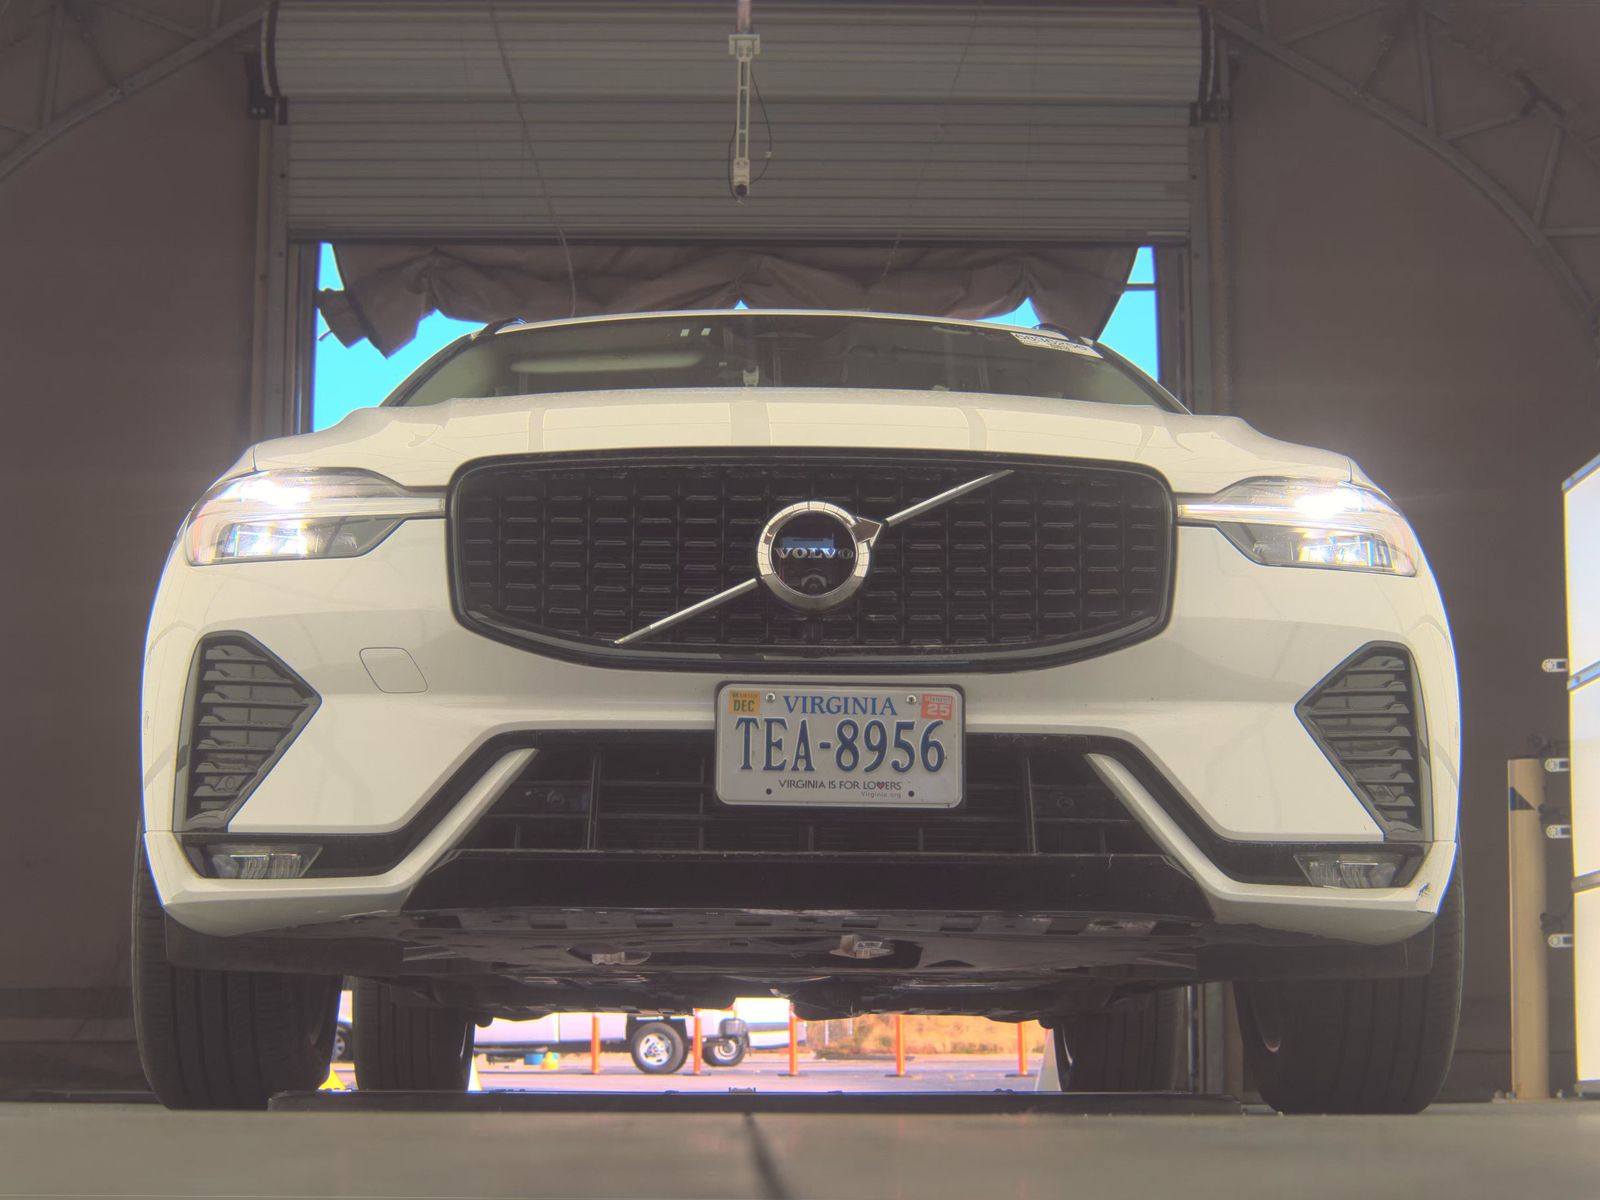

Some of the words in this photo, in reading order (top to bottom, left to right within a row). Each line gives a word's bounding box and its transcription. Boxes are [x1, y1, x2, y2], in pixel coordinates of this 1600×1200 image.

[775, 547, 854, 560] VOLVO
[733, 699, 755, 712] DEC
[784, 695, 898, 716] VIRGINIA
[927, 703, 950, 716] 25
[735, 717, 945, 773] TEA-8956
[778, 779, 826, 789] VIRGINIA
[828, 780, 837, 790] IS
[839, 780, 862, 791] FOR
